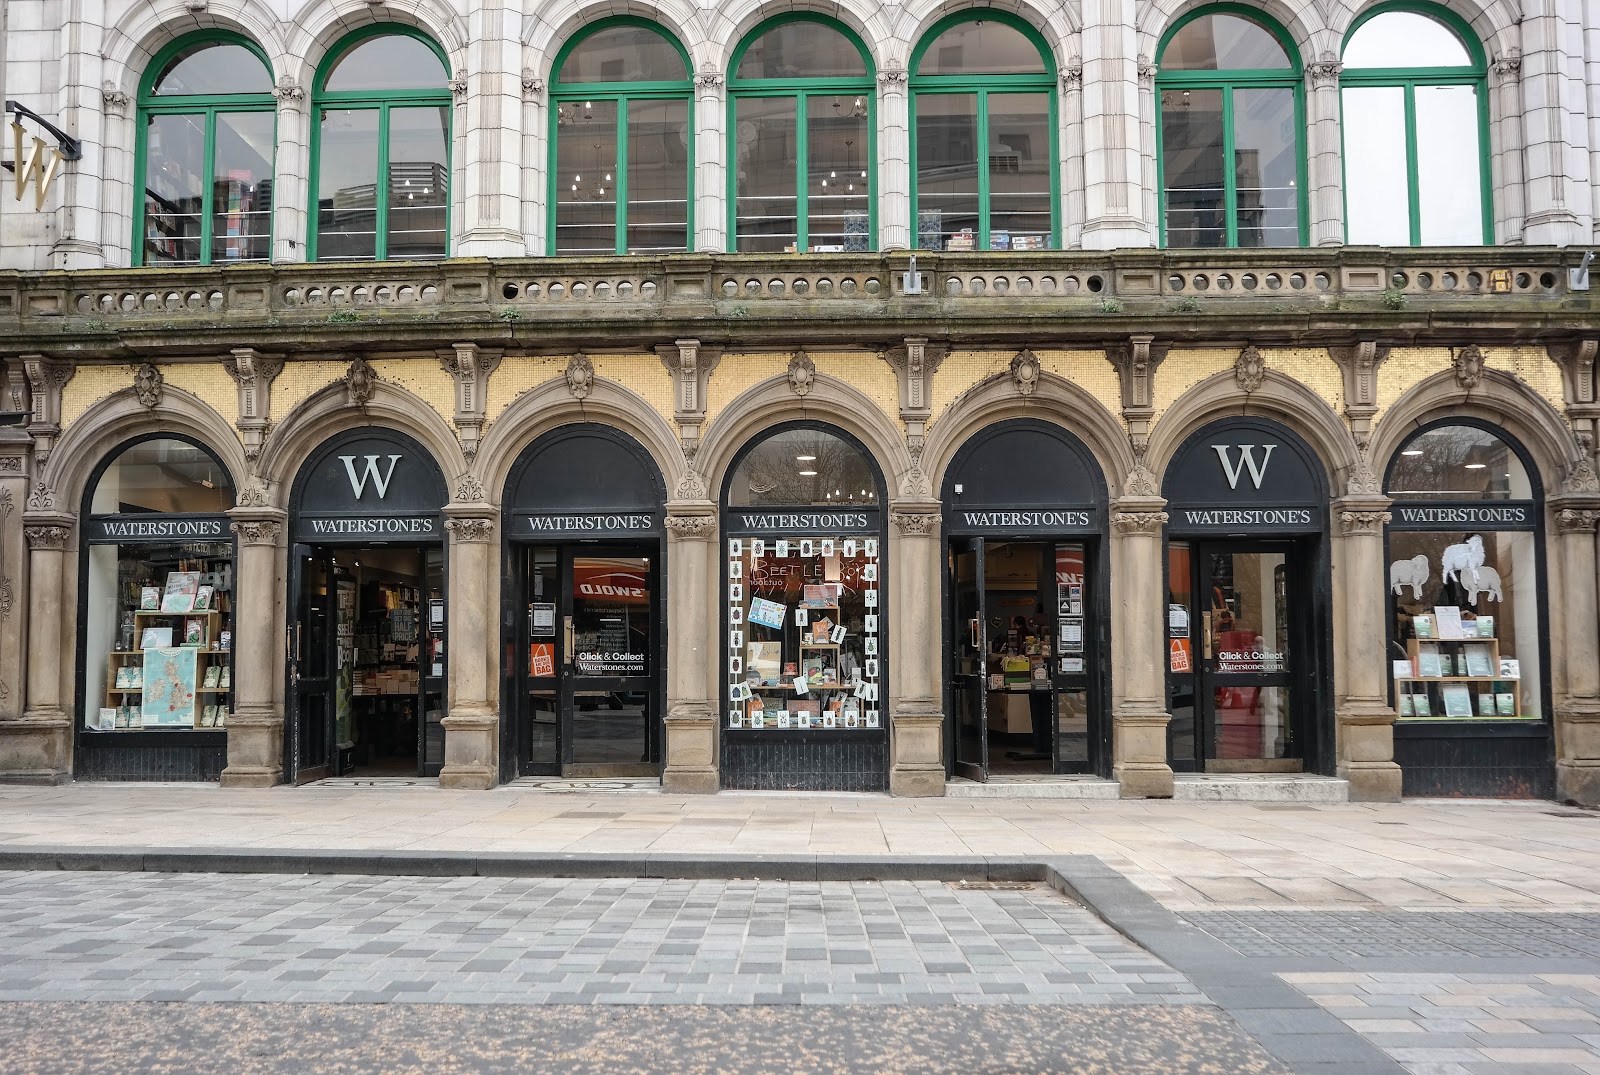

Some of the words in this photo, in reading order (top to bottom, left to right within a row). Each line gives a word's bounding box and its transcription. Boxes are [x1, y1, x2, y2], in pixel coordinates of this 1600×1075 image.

[10, 122, 65, 213] W
[1211, 444, 1278, 490] W
[338, 454, 403, 500] W
[742, 514, 868, 529] WATERSTONE'S
[963, 511, 1089, 526] WATERSTONE'S
[1185, 510, 1311, 525] WATERSTONE'S
[1400, 507, 1525, 522] WATERSTONE'S
[103, 521, 221, 536] WATERSTONE'S
[312, 518, 433, 533] WATERSTONE'S
[528, 515, 652, 530] WATERSTONE'S
[579, 651, 603, 661] Click
[603, 651, 612, 662] &
[612, 650, 644, 661] Collect
[1219, 651, 1242, 661] Click
[1243, 651, 1251, 661] &
[1251, 650, 1284, 661] Collect
[536, 664, 551, 674] BAG
[579, 662, 644, 672] Waterstones.com
[1172, 661, 1187, 670] BAG
[1219, 662, 1284, 672] Waterstones.com
